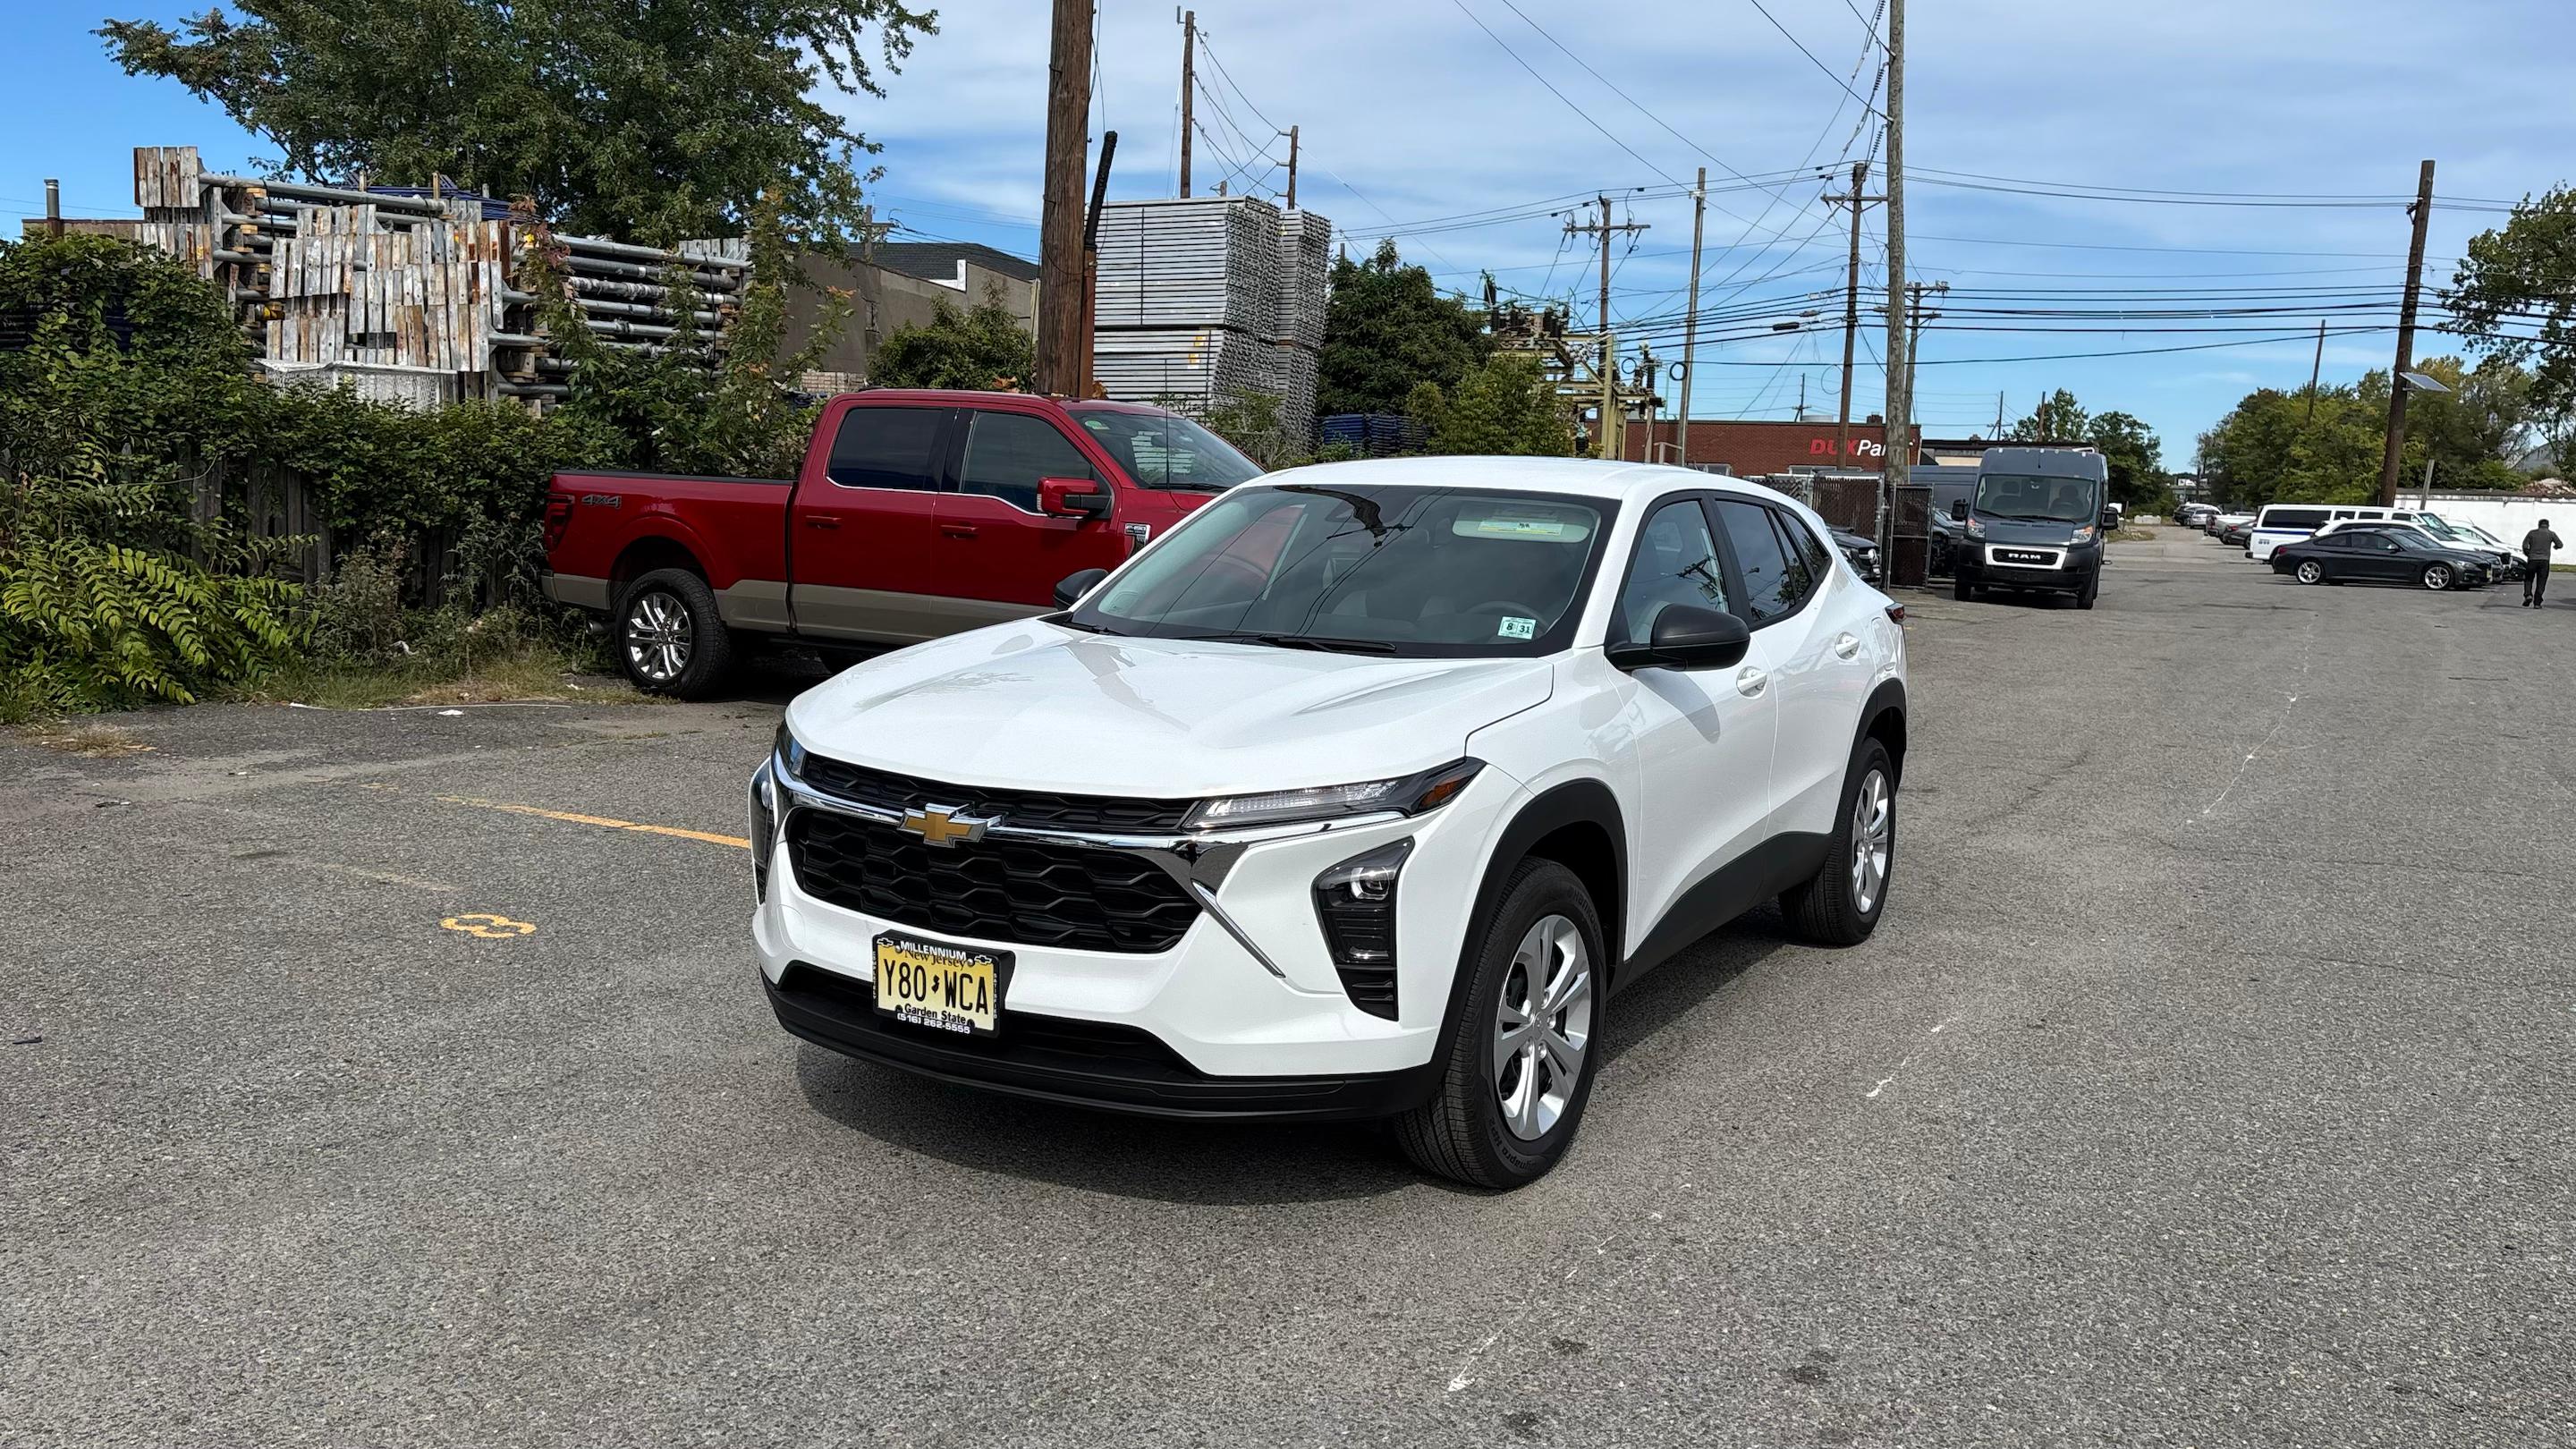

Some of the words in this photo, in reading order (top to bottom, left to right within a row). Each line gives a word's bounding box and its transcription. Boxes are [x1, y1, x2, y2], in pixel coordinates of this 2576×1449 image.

[1507, 623, 1513, 631] 8
[1520, 625, 1530, 633] 31
[900, 941, 967, 961] MILLENNIUM
[904, 950, 929, 961] New
[931, 953, 967, 970] Jersey
[884, 958, 927, 1002] Y80
[944, 970, 988, 1015] WCA
[897, 1013, 921, 1024] (516)
[924, 1019, 970, 1034] 262-5555
[904, 1004, 937, 1020] Garden
[941, 1010, 967, 1025] State
